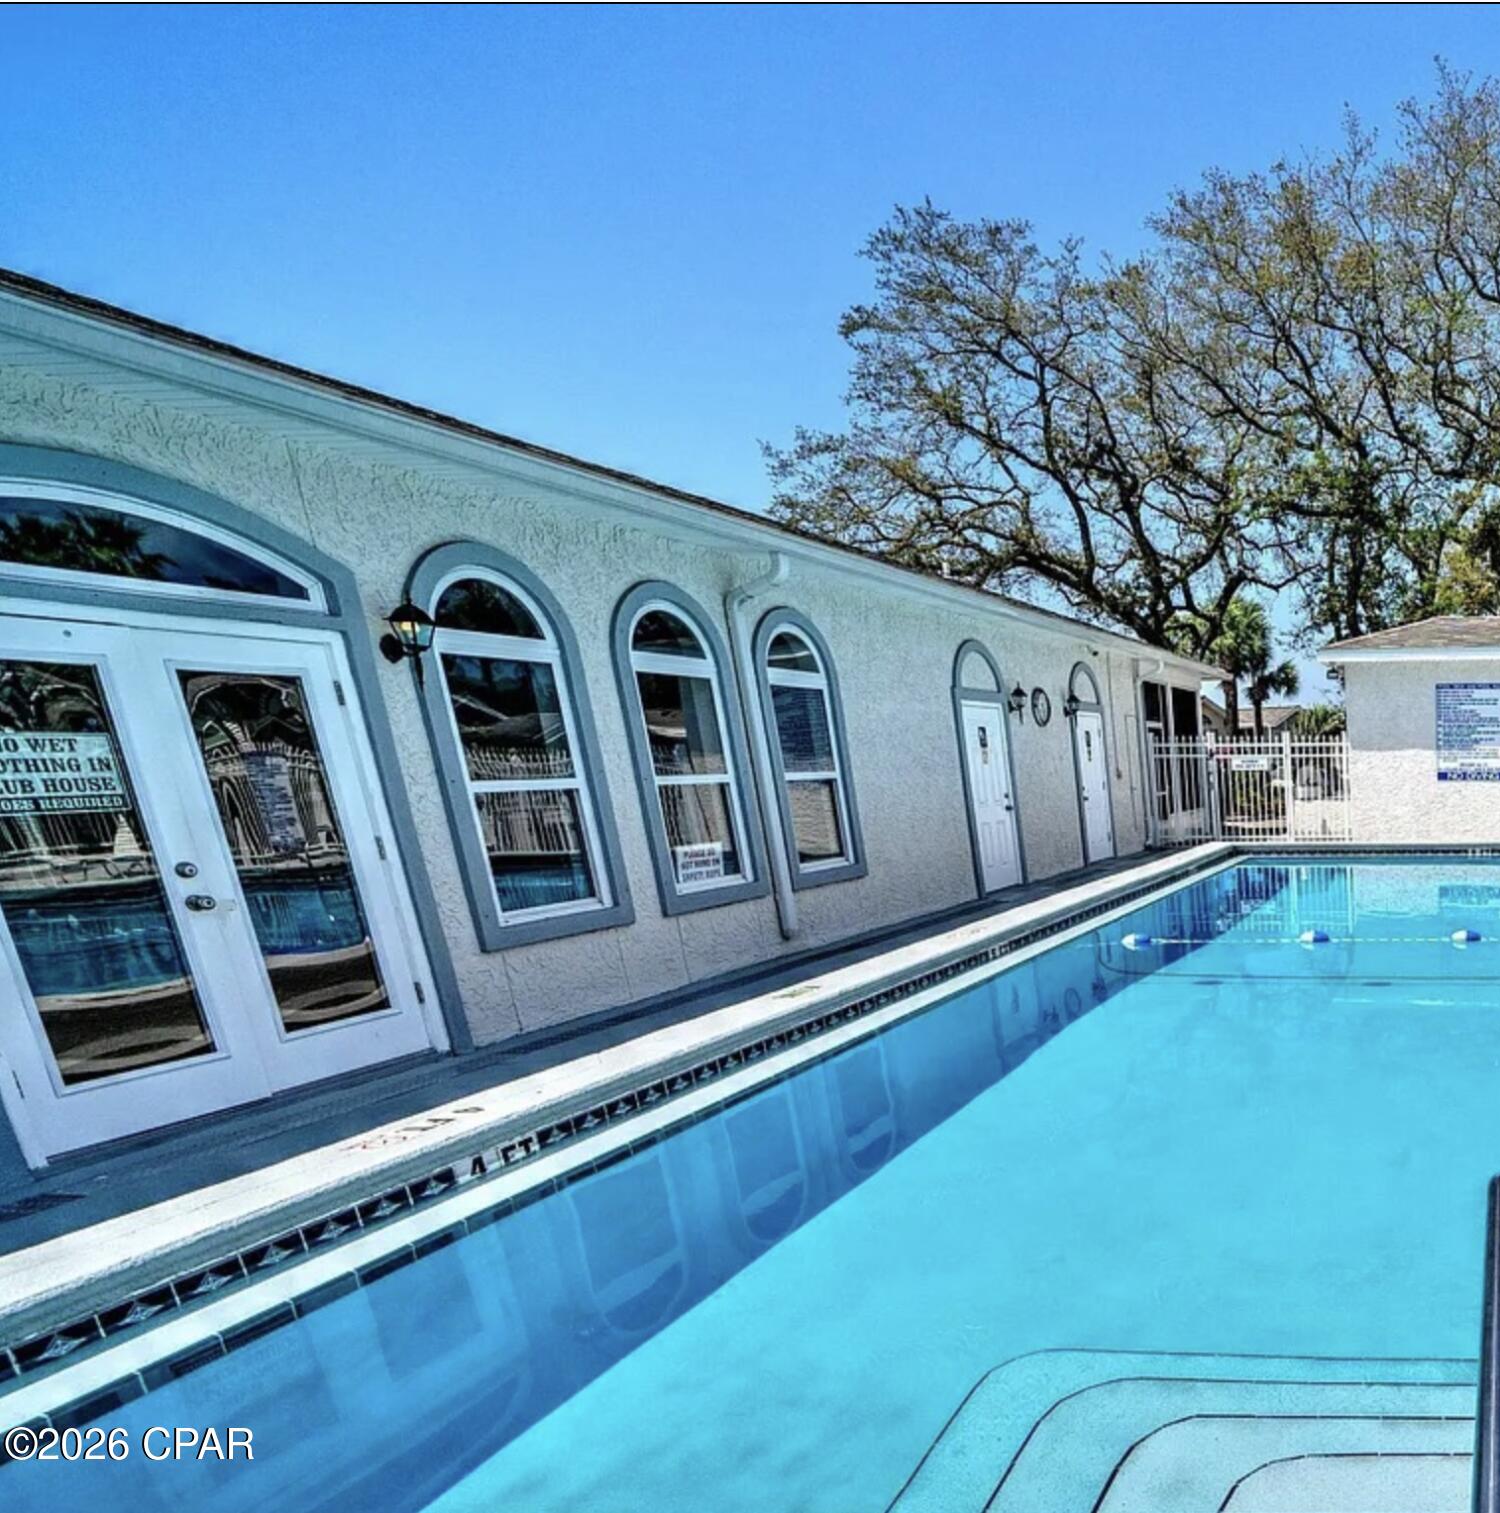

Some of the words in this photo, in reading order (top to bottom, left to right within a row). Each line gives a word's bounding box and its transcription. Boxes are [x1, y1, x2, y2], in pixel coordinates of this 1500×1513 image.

[0, 738, 19, 753] O
[25, 738, 77, 753] WET
[87, 757, 112, 772] IN
[42, 777, 117, 793] HOUSE
[40, 796, 123, 810] REQUIRED
[500, 1136, 533, 1164] FT
